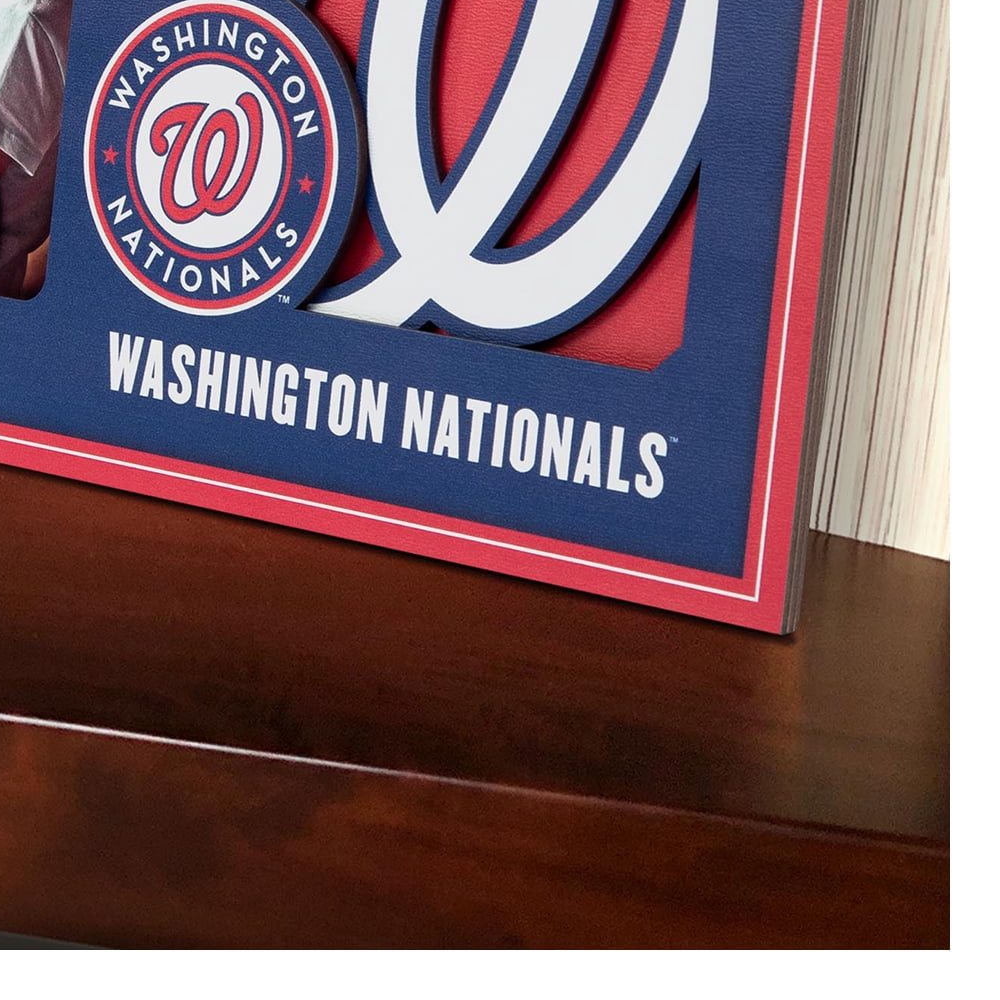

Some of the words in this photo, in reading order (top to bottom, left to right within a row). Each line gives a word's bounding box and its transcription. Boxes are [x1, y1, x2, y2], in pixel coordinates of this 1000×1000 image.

[108, 19, 319, 138] WASHINGTON
[150, 91, 264, 224] W
[107, 195, 298, 294] NATIONALS
[108, 331, 388, 444] WASHINGTON
[401, 387, 668, 499] NATIONALS
